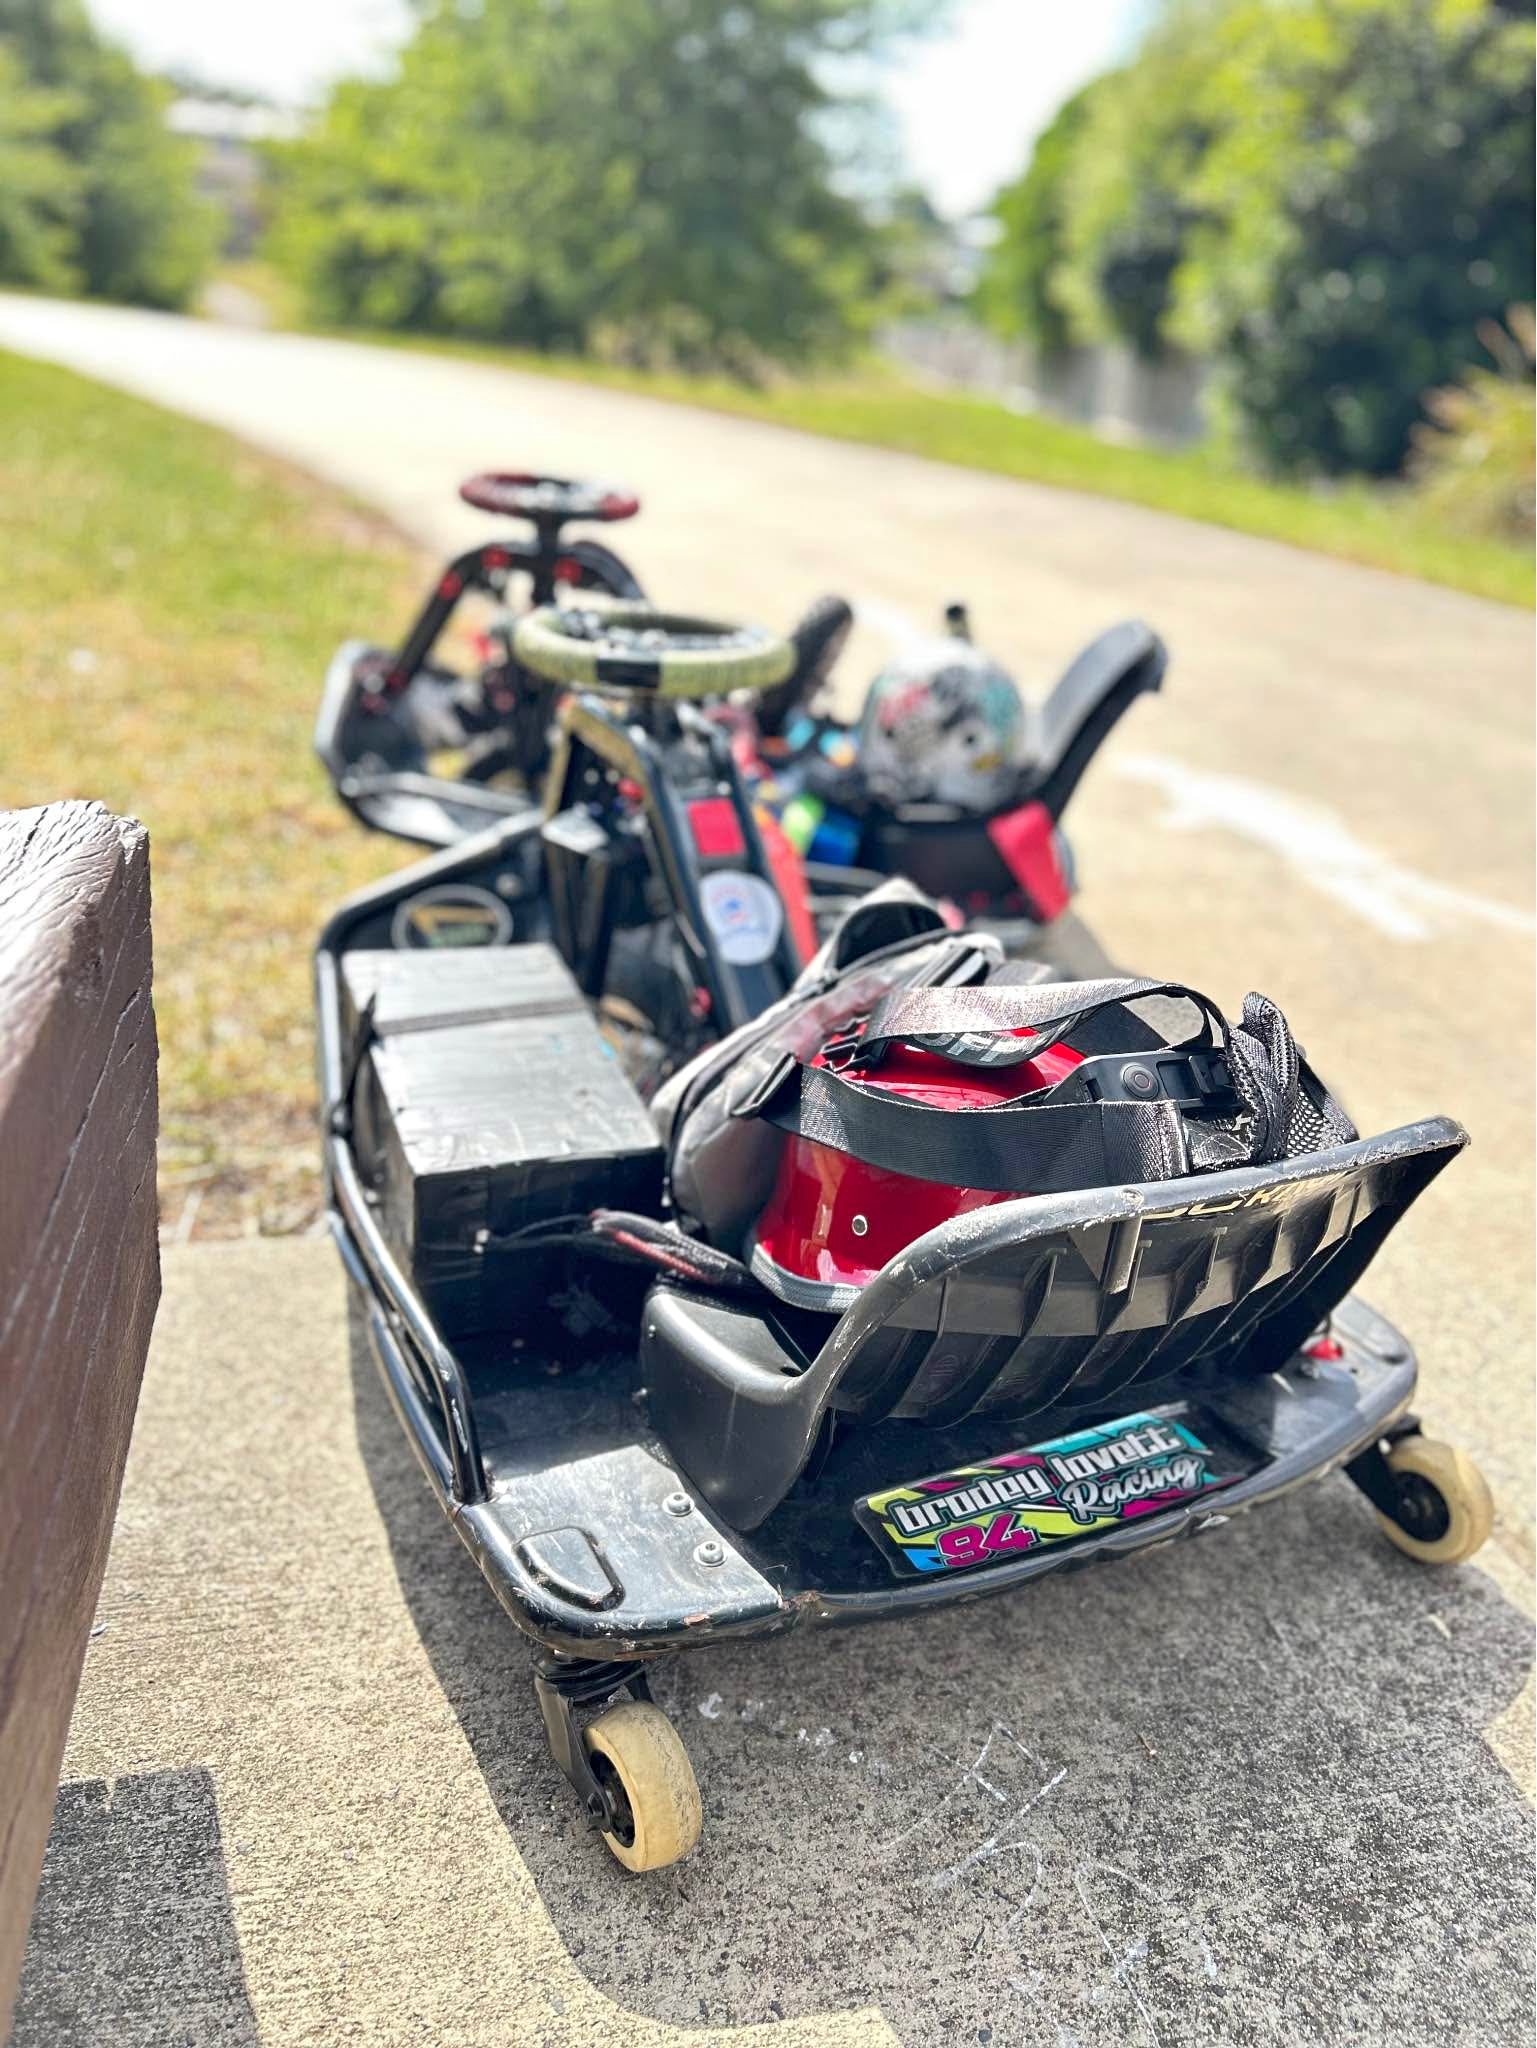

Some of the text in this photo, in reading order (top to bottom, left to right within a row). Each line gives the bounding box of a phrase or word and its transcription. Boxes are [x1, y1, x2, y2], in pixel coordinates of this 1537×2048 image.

[894, 1426, 1181, 1533] brodey lovett
[1061, 1458, 1200, 1520] Racing
[938, 1510, 1038, 1568] 94
